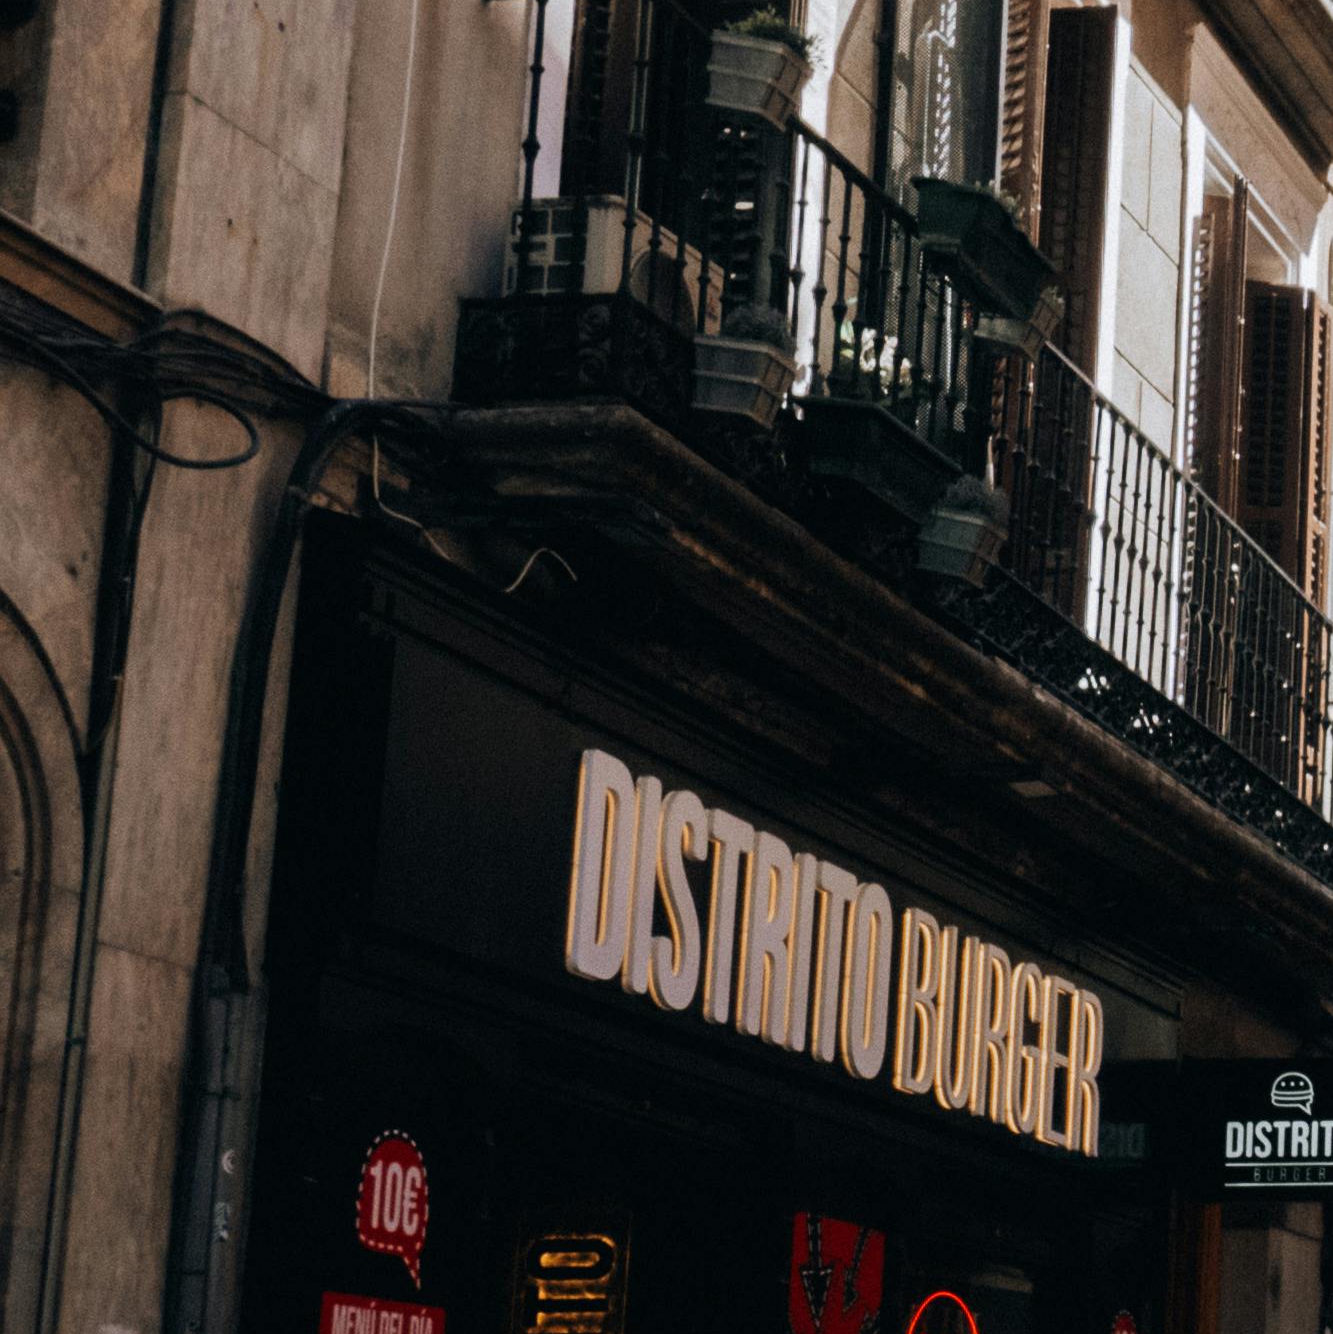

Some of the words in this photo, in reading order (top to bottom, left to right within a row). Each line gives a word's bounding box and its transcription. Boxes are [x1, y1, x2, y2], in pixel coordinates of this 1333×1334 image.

[566, 748, 894, 1080] DISTRITO
[893, 907, 1105, 1159] BURGER
[369, 1159, 422, 1236] 10€
[1253, 1167, 1328, 1182] BURGER
